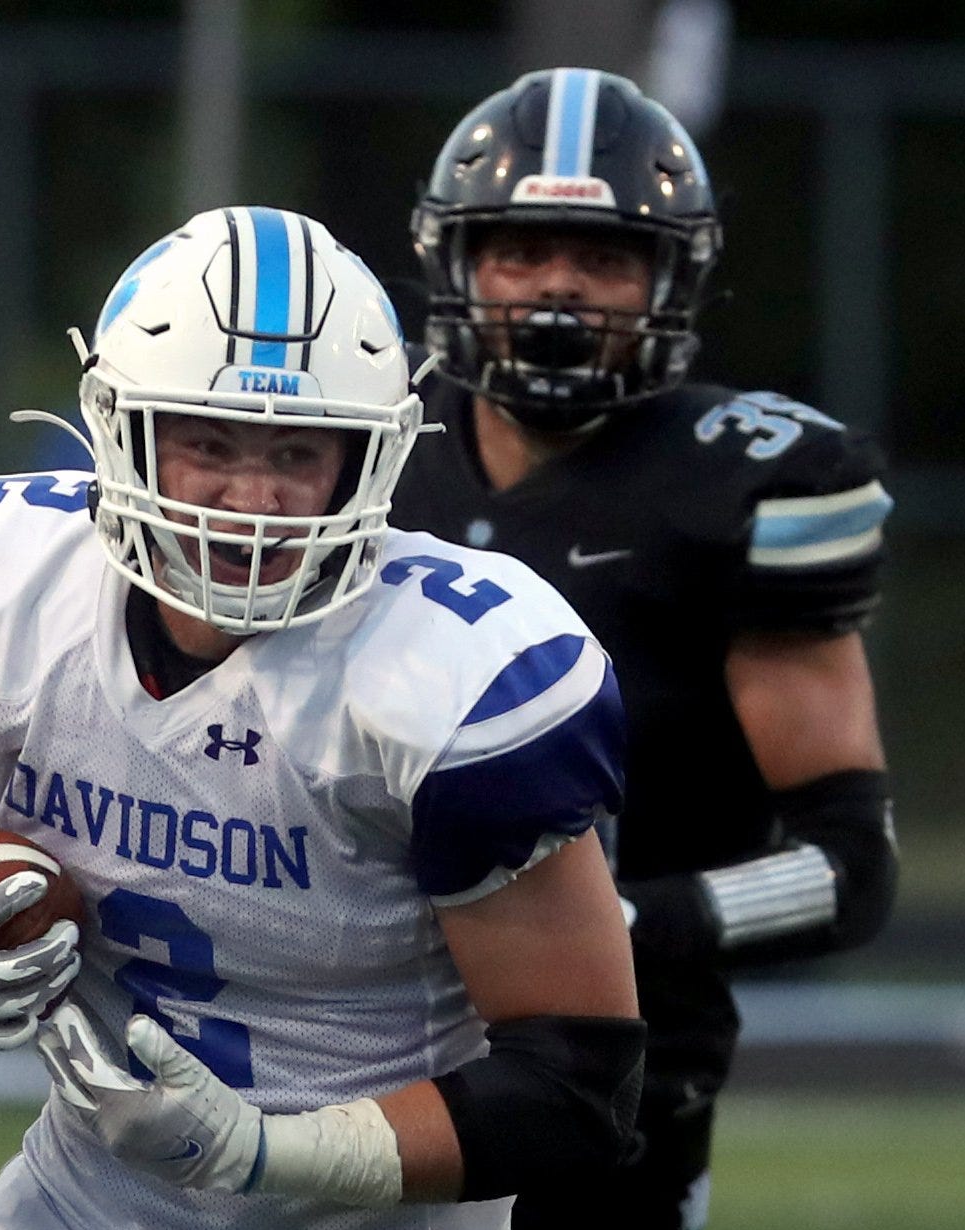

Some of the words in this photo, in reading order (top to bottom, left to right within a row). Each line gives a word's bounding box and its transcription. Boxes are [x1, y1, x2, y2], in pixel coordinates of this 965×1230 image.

[239, 371, 300, 396] TEAM
[380, 554, 513, 626] 2
[5, 763, 311, 889] DAVIDSON
[97, 887, 254, 1088] 2
